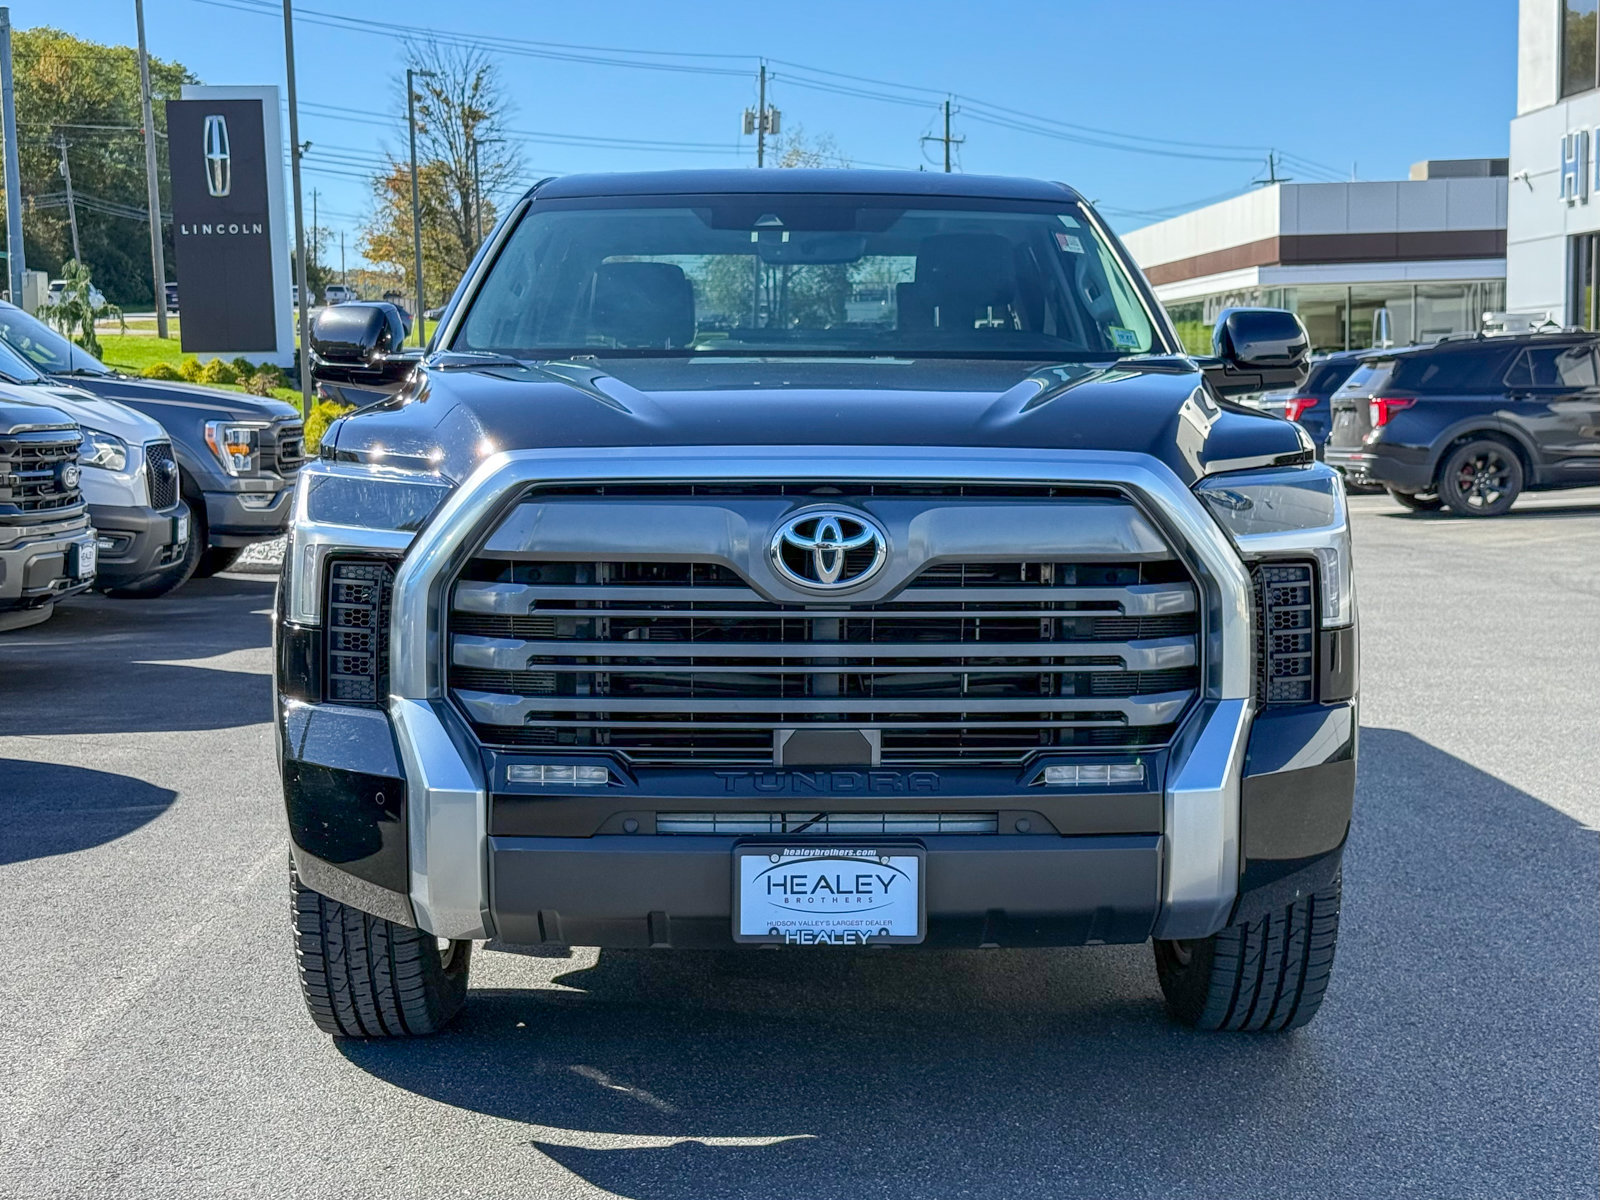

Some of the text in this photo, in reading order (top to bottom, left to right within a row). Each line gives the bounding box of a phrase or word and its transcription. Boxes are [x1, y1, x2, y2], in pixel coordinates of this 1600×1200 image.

[181, 223, 262, 235] LINCOLN
[714, 771, 941, 792] TUNDRA
[783, 848, 877, 857] healeybrothers.com
[767, 874, 897, 895] HEALEY
[799, 919, 831, 927] VALLEY'S
[784, 929, 873, 945] HEALEY
